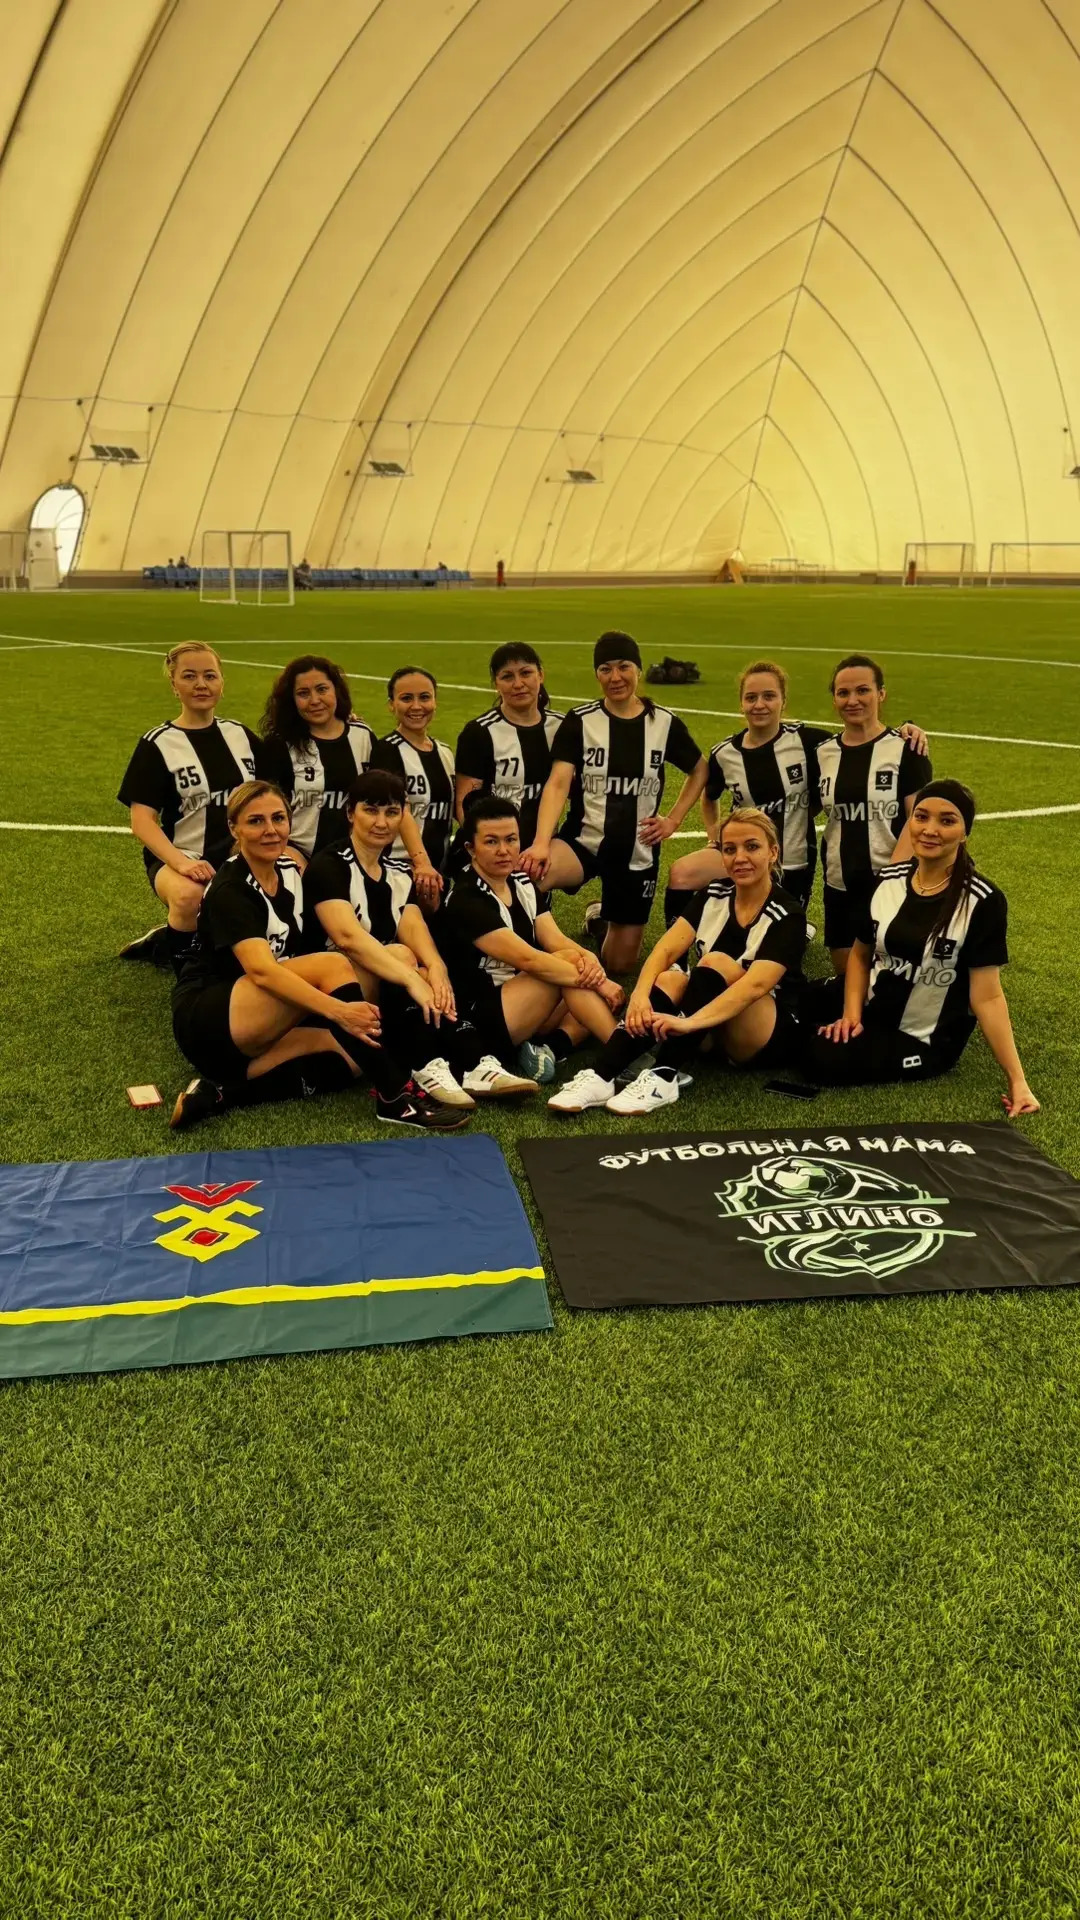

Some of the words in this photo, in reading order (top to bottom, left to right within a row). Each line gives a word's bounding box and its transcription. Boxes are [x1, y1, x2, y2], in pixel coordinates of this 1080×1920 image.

[499, 757, 520, 777] 77
[586, 747, 605, 768] 20
[177, 765, 202, 789] 55
[303, 766, 316, 782] 9
[406, 774, 427, 796] 29
[580, 773, 662, 797] ИГЛИНО
[598, 1135, 851, 1170] ФУТБОЛЬНАЯ
[857, 1135, 977, 1156] МАМА
[745, 1205, 945, 1235] ИГЛИНО
